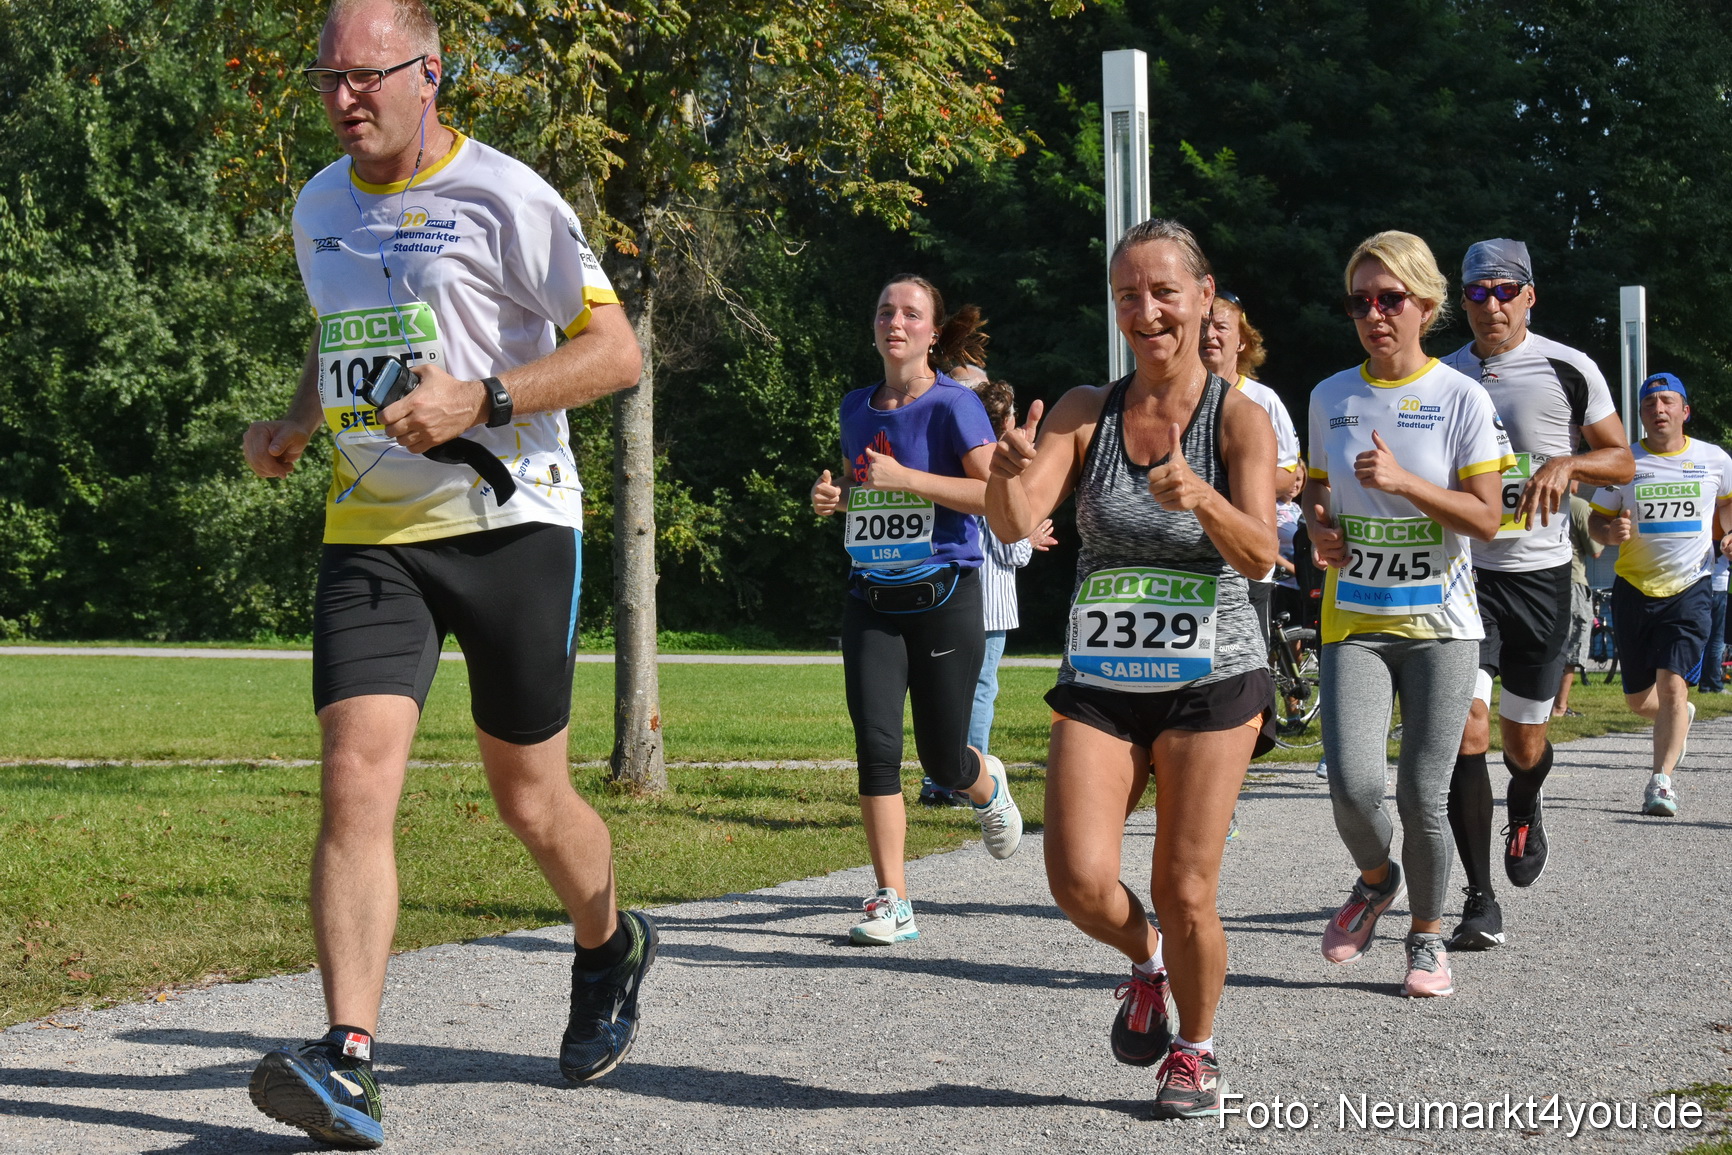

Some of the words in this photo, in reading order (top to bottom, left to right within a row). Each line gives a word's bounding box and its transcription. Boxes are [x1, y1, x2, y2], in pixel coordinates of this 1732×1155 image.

[401, 212, 427, 228] 20
[427, 220, 453, 228] JAHRE
[395, 229, 461, 243] Neumarkter
[393, 243, 445, 255] Stadtlauf
[326, 312, 418, 345] BOCK
[1400, 399, 1420, 412] 20
[340, 407, 386, 429] STE
[1398, 412, 1446, 422] Neumarkter
[1397, 421, 1436, 431] Stadtlauf
[518, 458, 531, 477] 2019
[1682, 462, 1694, 470] 20
[854, 489, 922, 506] BOCK
[1641, 484, 1694, 497] BOCK
[1644, 501, 1695, 520] 2779
[855, 513, 923, 541] 2089
[1349, 521, 1431, 542] BOCK
[871, 548, 902, 560] LISA
[1349, 548, 1431, 581] 2745
[1091, 574, 1199, 601] BOCK
[1352, 589, 1394, 603] ANNA
[1086, 610, 1199, 650] 2329
[1203, 616, 1210, 624] D
[1100, 661, 1181, 679] SABINE
